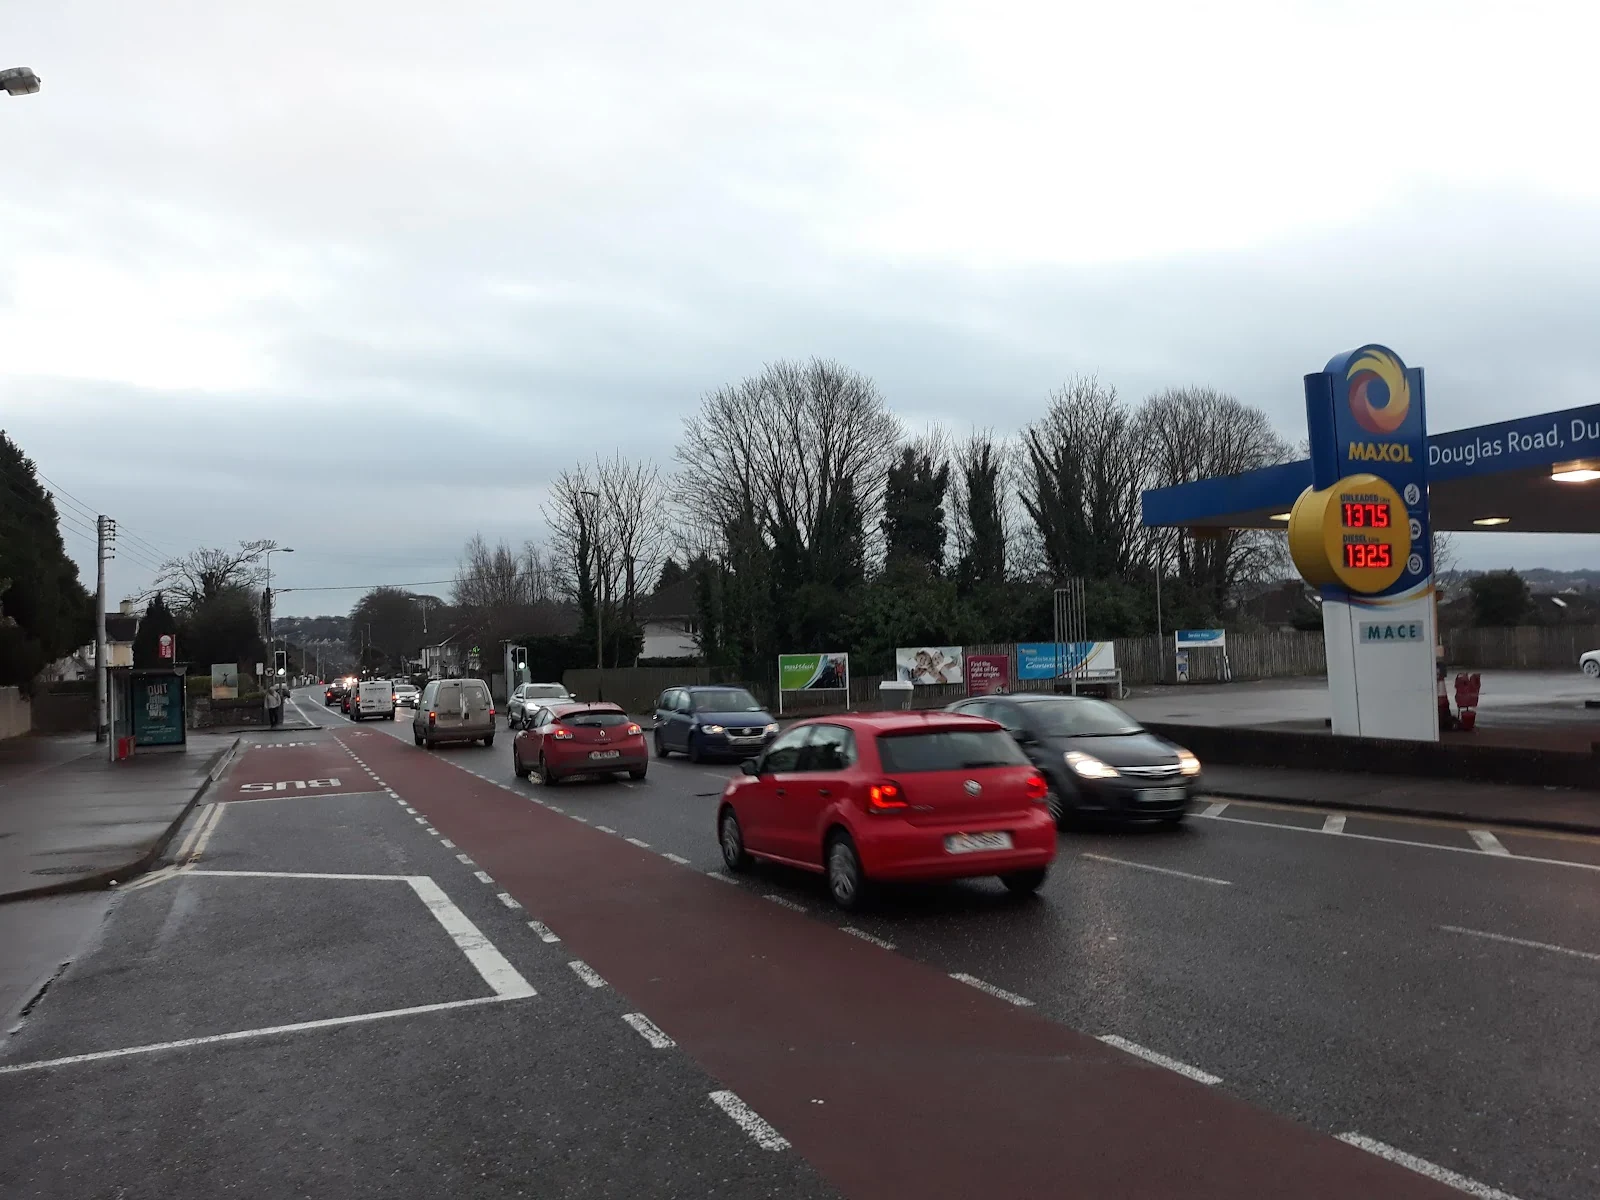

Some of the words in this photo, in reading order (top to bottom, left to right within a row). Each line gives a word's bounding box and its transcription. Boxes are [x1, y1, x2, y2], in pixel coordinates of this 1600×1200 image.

[1348, 441, 1413, 463] MAXOL
[1428, 439, 1502, 466] Douglas
[1508, 423, 1565, 453] Road,
[1368, 624, 1416, 640] MACE
[147, 683, 168, 695] QUIT
[239, 778, 342, 793] BUS
